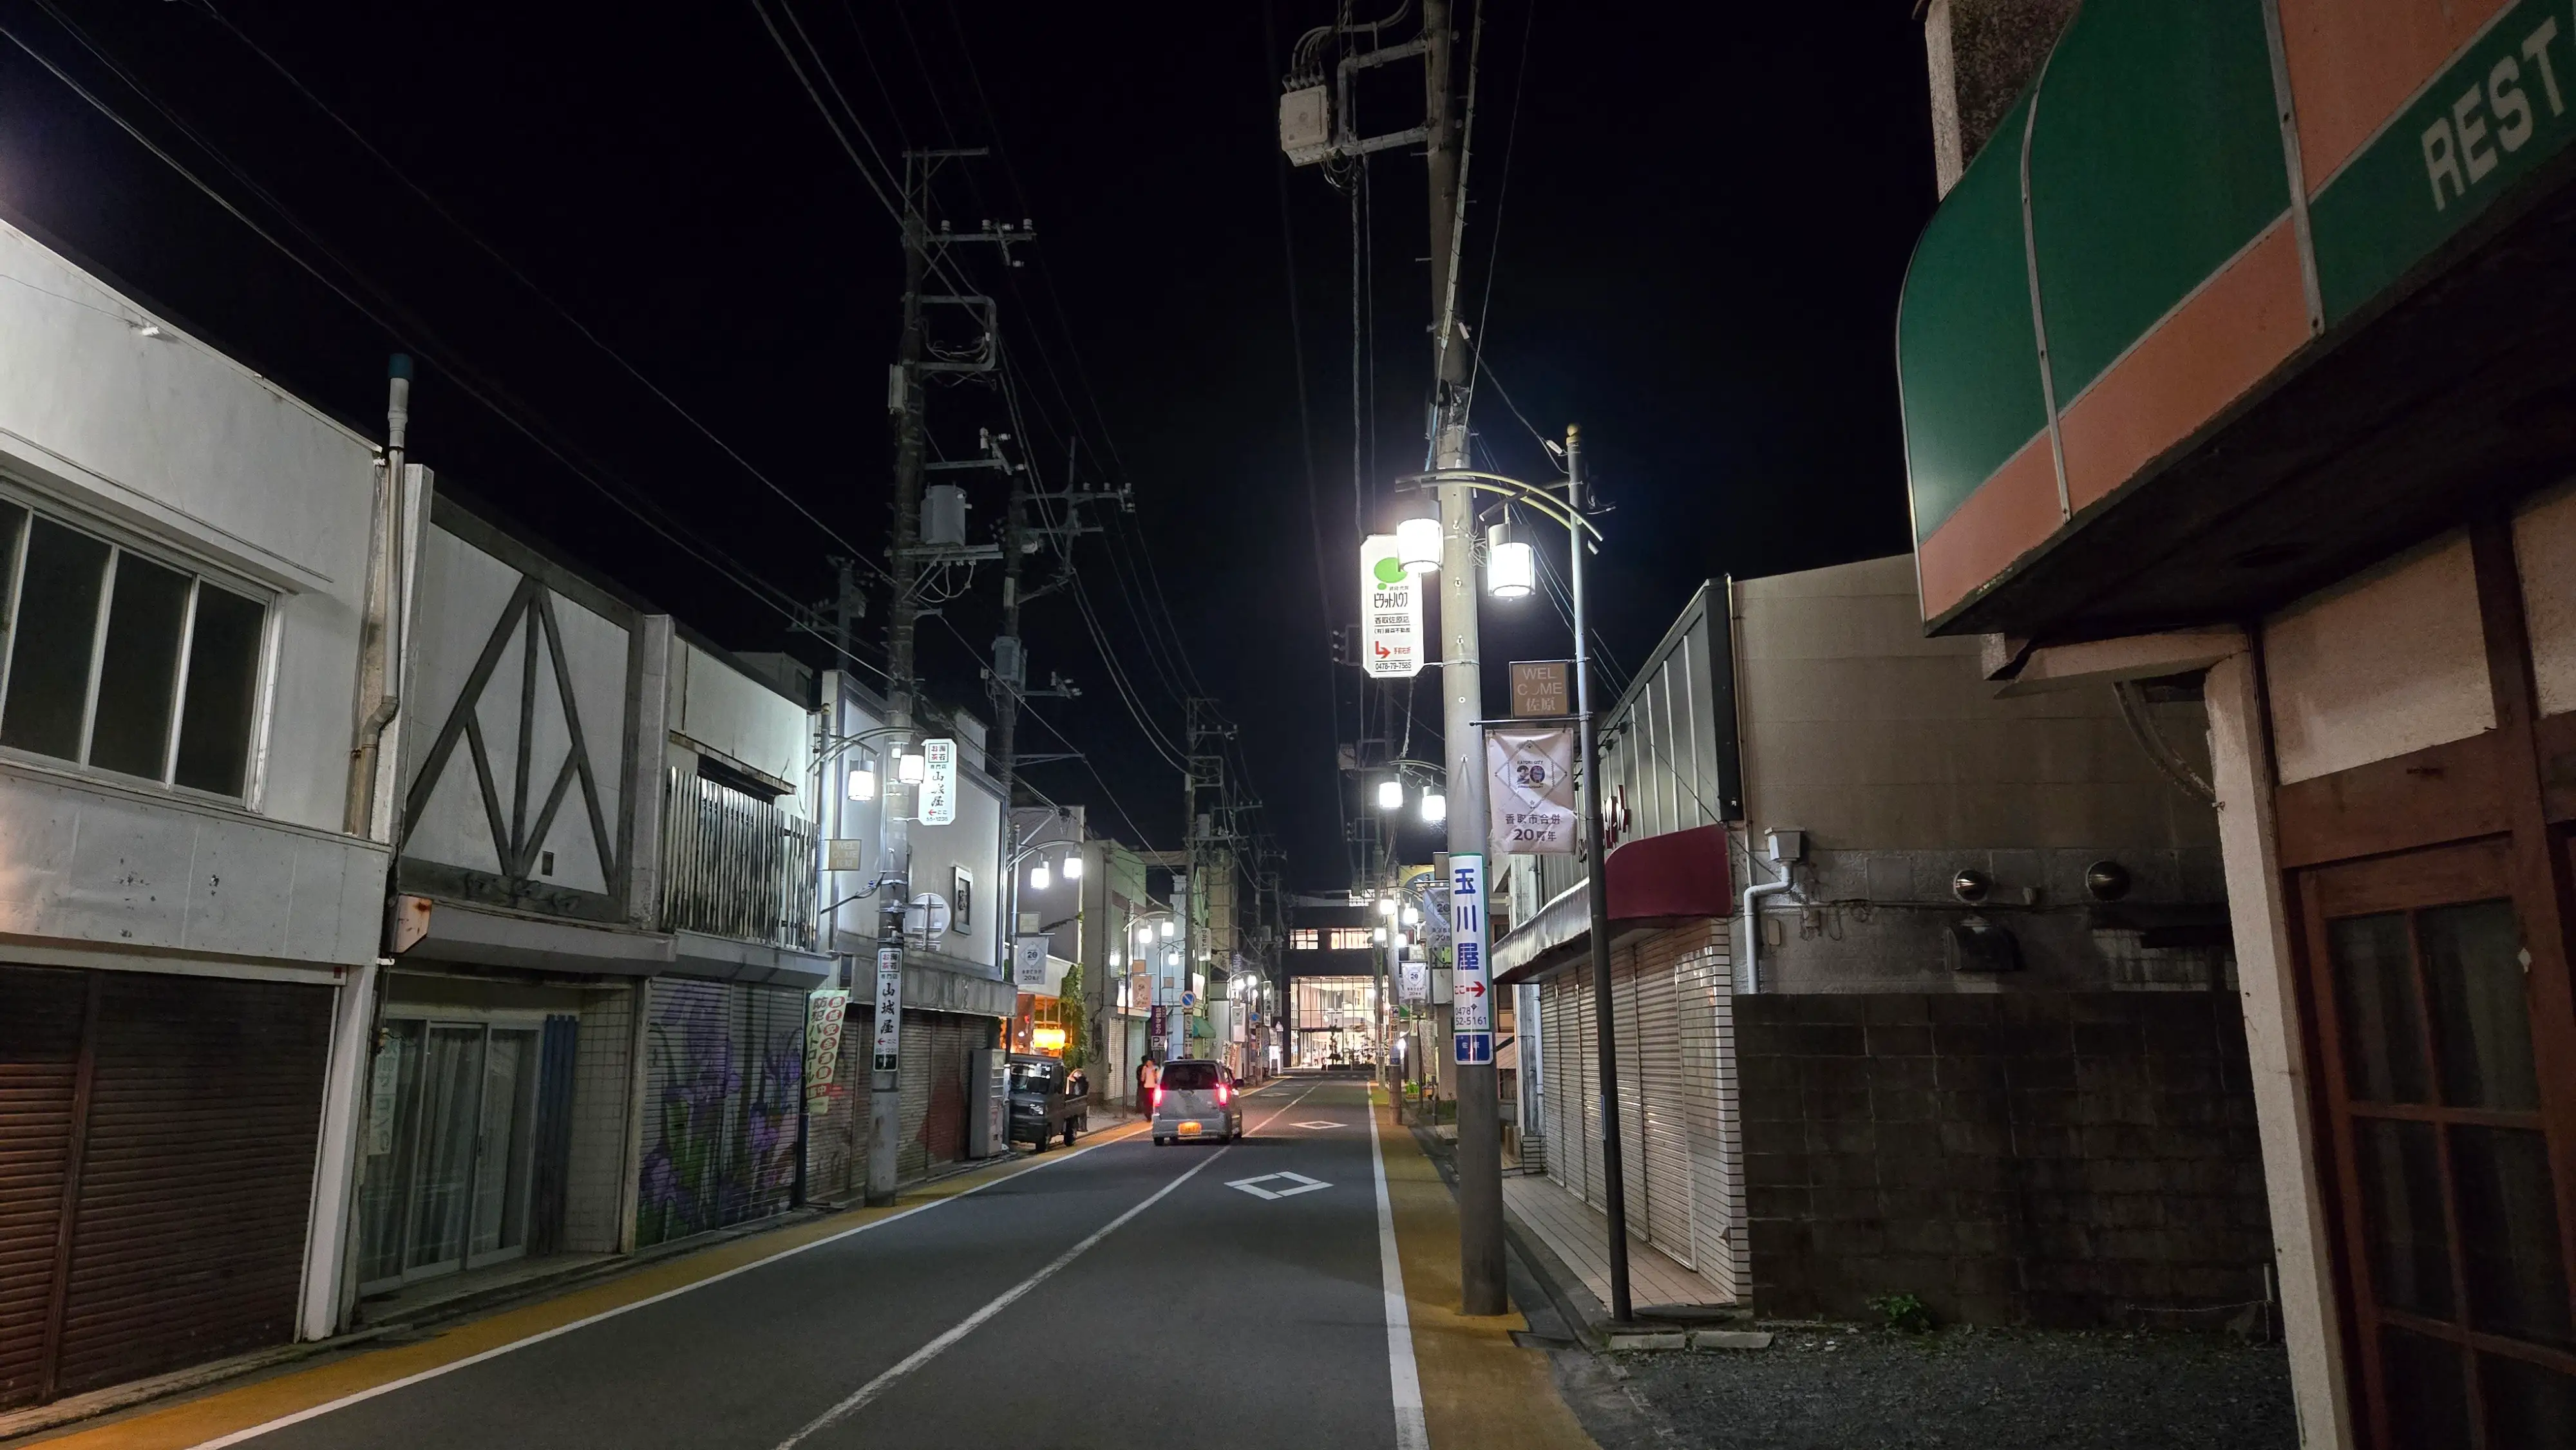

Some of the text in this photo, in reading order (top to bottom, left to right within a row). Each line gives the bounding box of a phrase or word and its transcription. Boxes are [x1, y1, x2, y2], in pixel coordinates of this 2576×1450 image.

[2421, 15, 2564, 212] REST
[1522, 667, 1557, 680] WEL
[1526, 696, 1556, 712] 佐原
[1505, 813, 1561, 825] 香取市合併
[1513, 828, 1557, 842] 20周年
[1454, 868, 1479, 971] 玉川屋
[880, 983, 896, 1035] 山城屋
[1455, 1006, 1472, 1016] 0478
[1455, 1016, 1487, 1026] 52-5161
